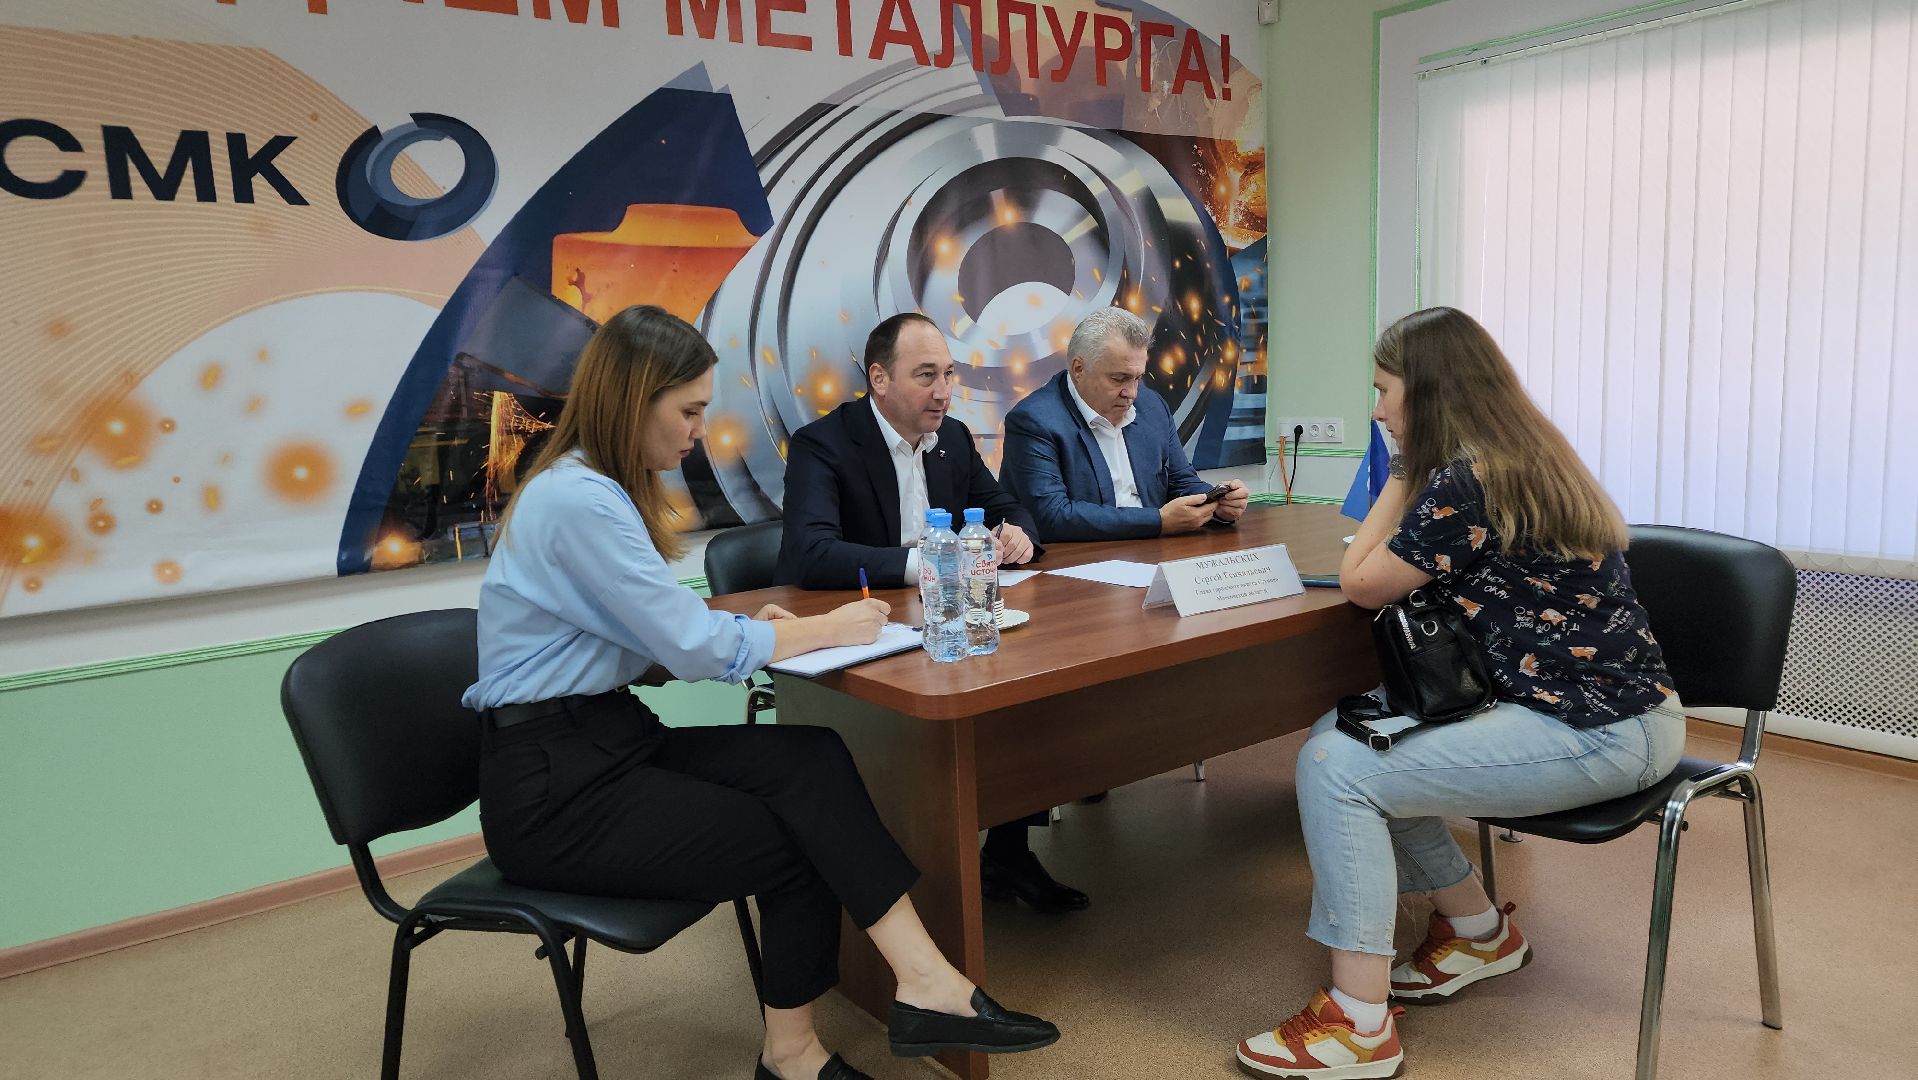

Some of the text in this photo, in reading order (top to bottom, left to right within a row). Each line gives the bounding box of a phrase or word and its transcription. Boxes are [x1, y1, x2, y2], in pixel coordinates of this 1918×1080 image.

[0, 118, 310, 206] СМК
[1195, 552, 1260, 570] МУЖАЛЬСКИХ
[1194, 573, 1223, 585] Сергей
